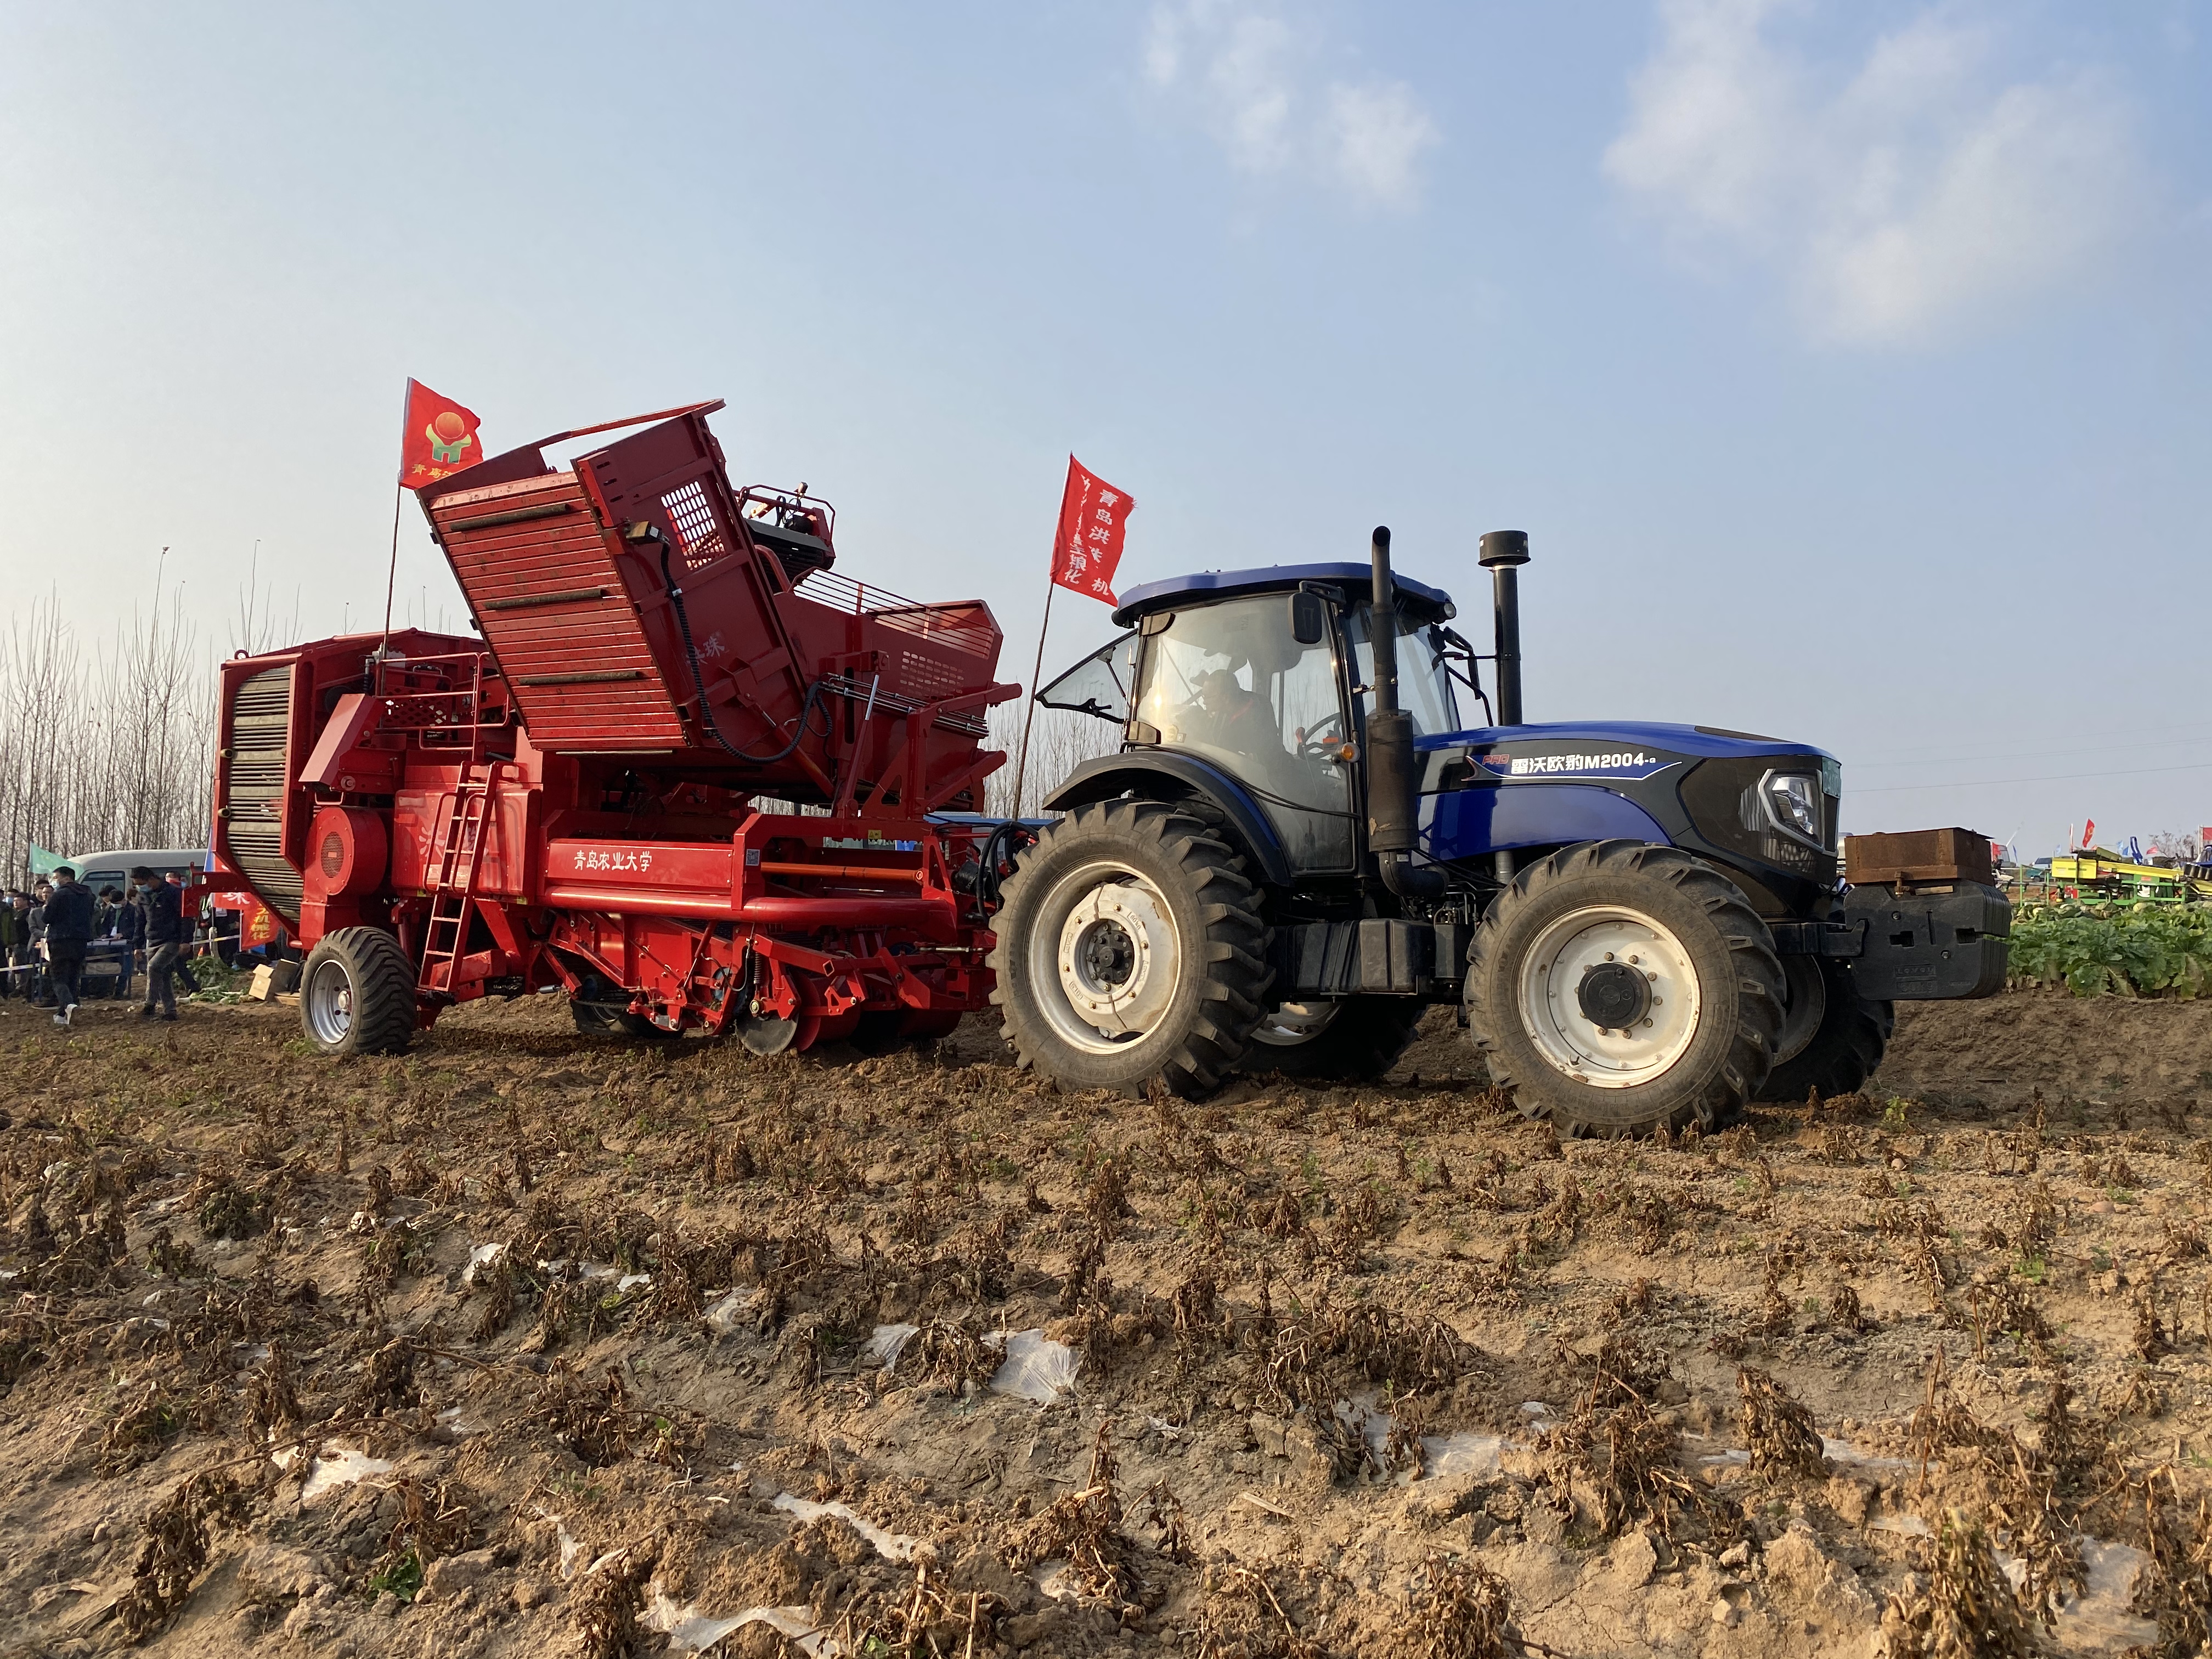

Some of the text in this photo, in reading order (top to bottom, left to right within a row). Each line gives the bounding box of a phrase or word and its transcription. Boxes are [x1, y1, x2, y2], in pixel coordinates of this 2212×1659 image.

[574, 849, 652, 872] 青岛农业大学
